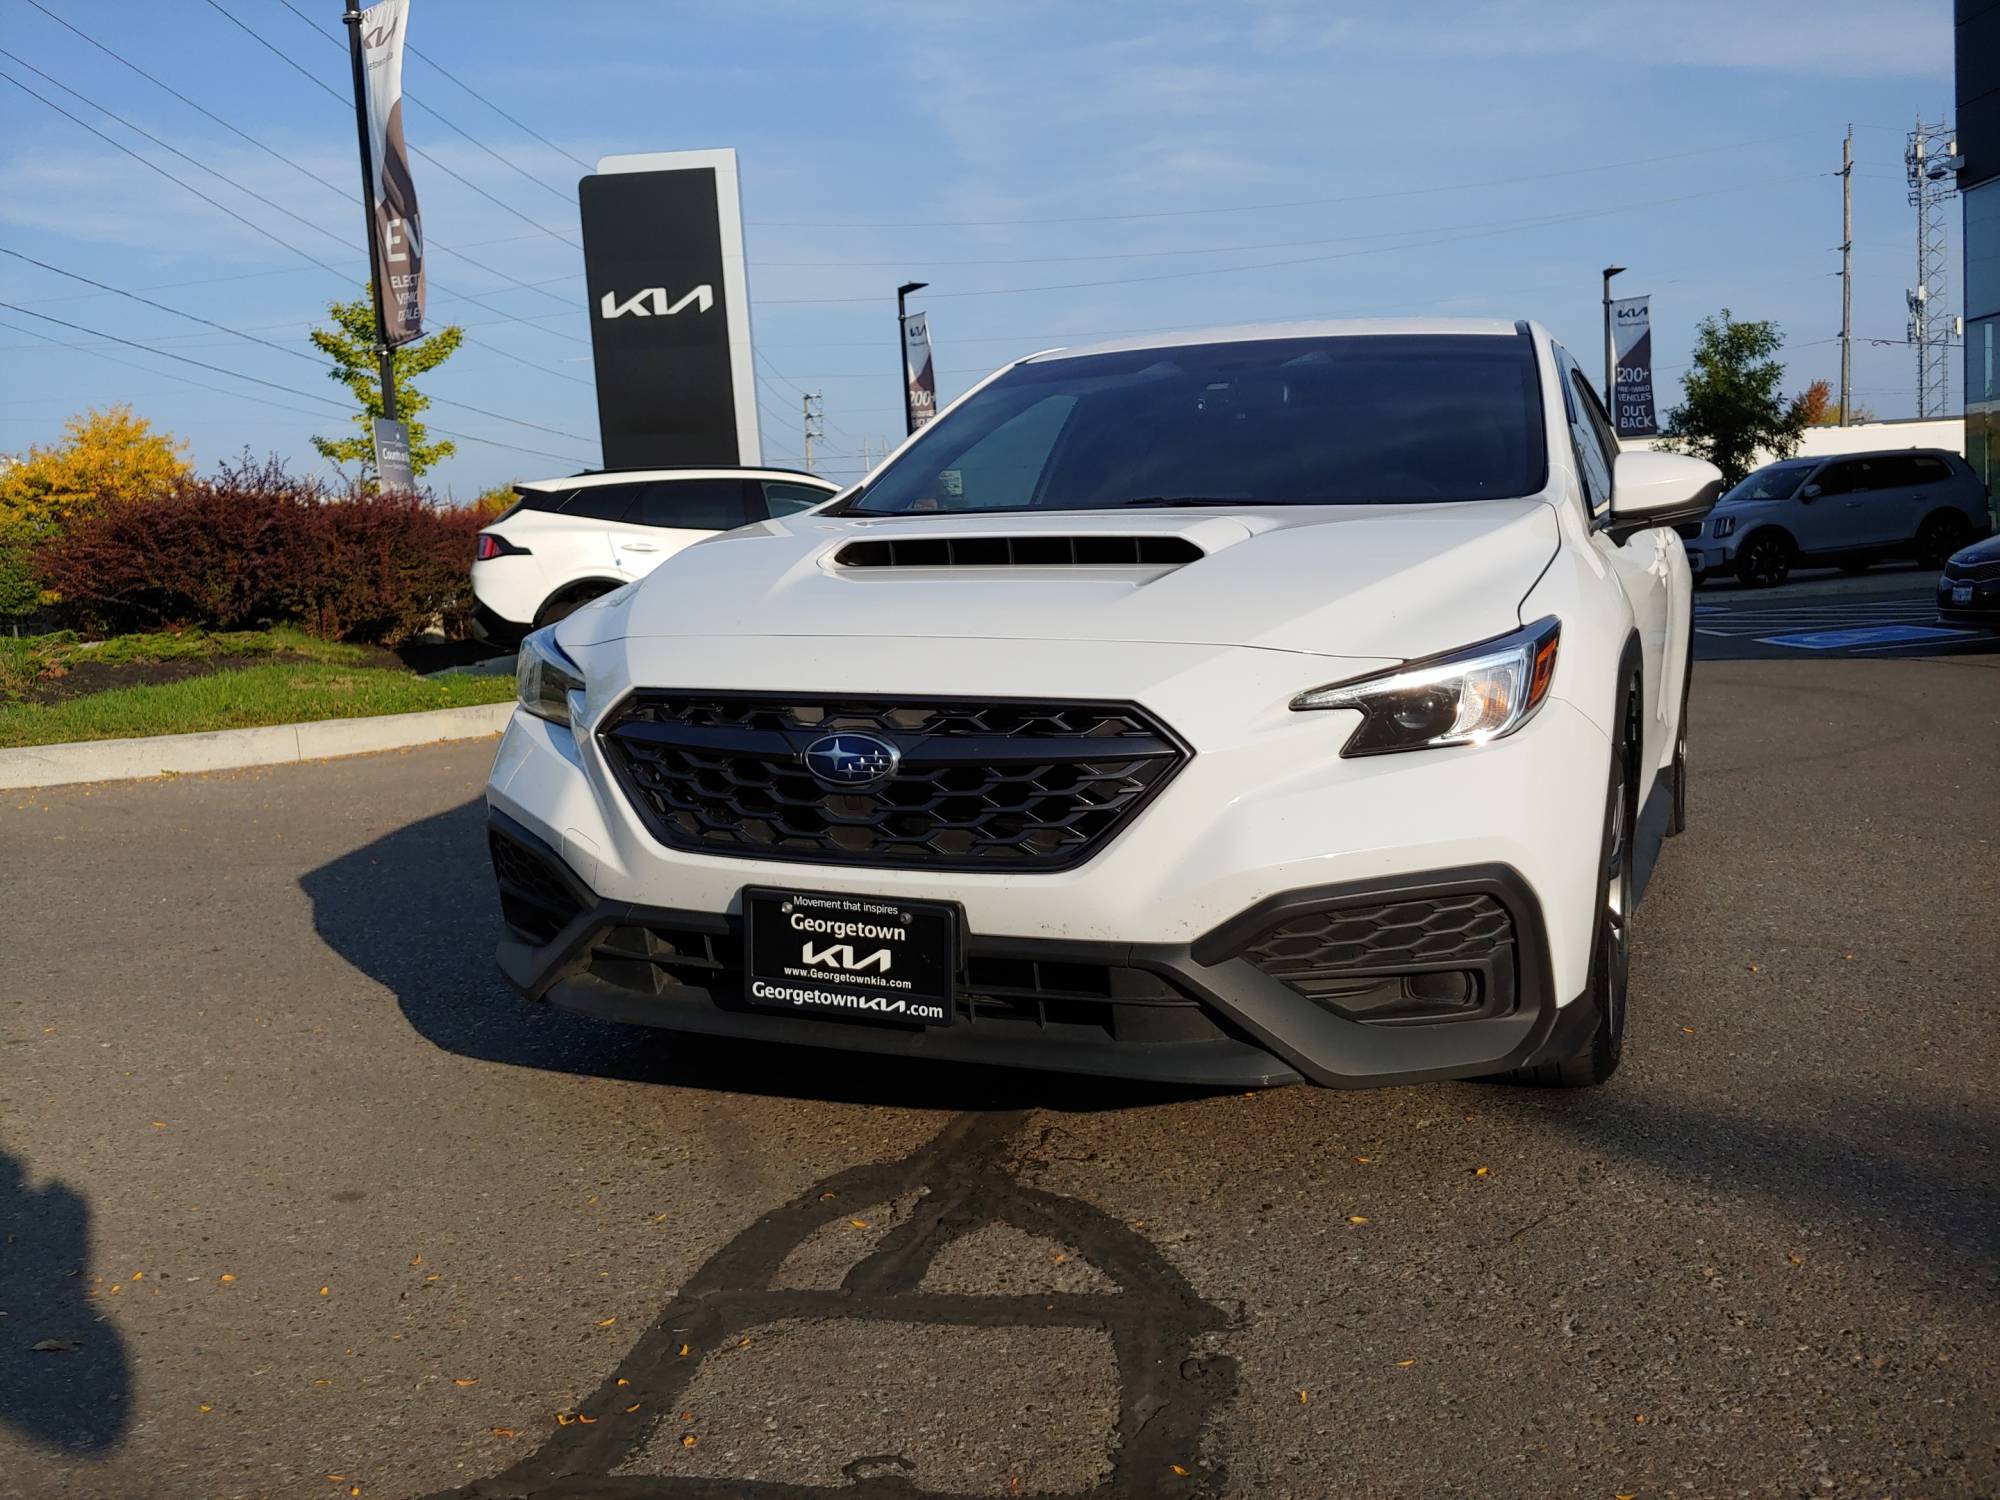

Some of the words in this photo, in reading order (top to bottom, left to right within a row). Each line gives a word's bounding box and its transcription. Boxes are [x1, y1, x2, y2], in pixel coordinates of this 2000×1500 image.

[385, 213, 422, 262] EV
[391, 273, 421, 289] ELECT
[396, 291, 418, 306] VEHIC
[601, 284, 713, 319] KIA
[398, 307, 420, 323] DEALE
[1617, 306, 1648, 318] KIA
[1617, 367, 1649, 383] 200+
[1622, 405, 1646, 417] OUT
[1621, 415, 1653, 428] BACK
[793, 895, 842, 909] Movement
[843, 901, 861, 912] that
[863, 903, 898, 915] inspires
[790, 913, 906, 941] Georgetown
[802, 941, 891, 973] KIA
[784, 966, 912, 989] www.Georgetownkia.com
